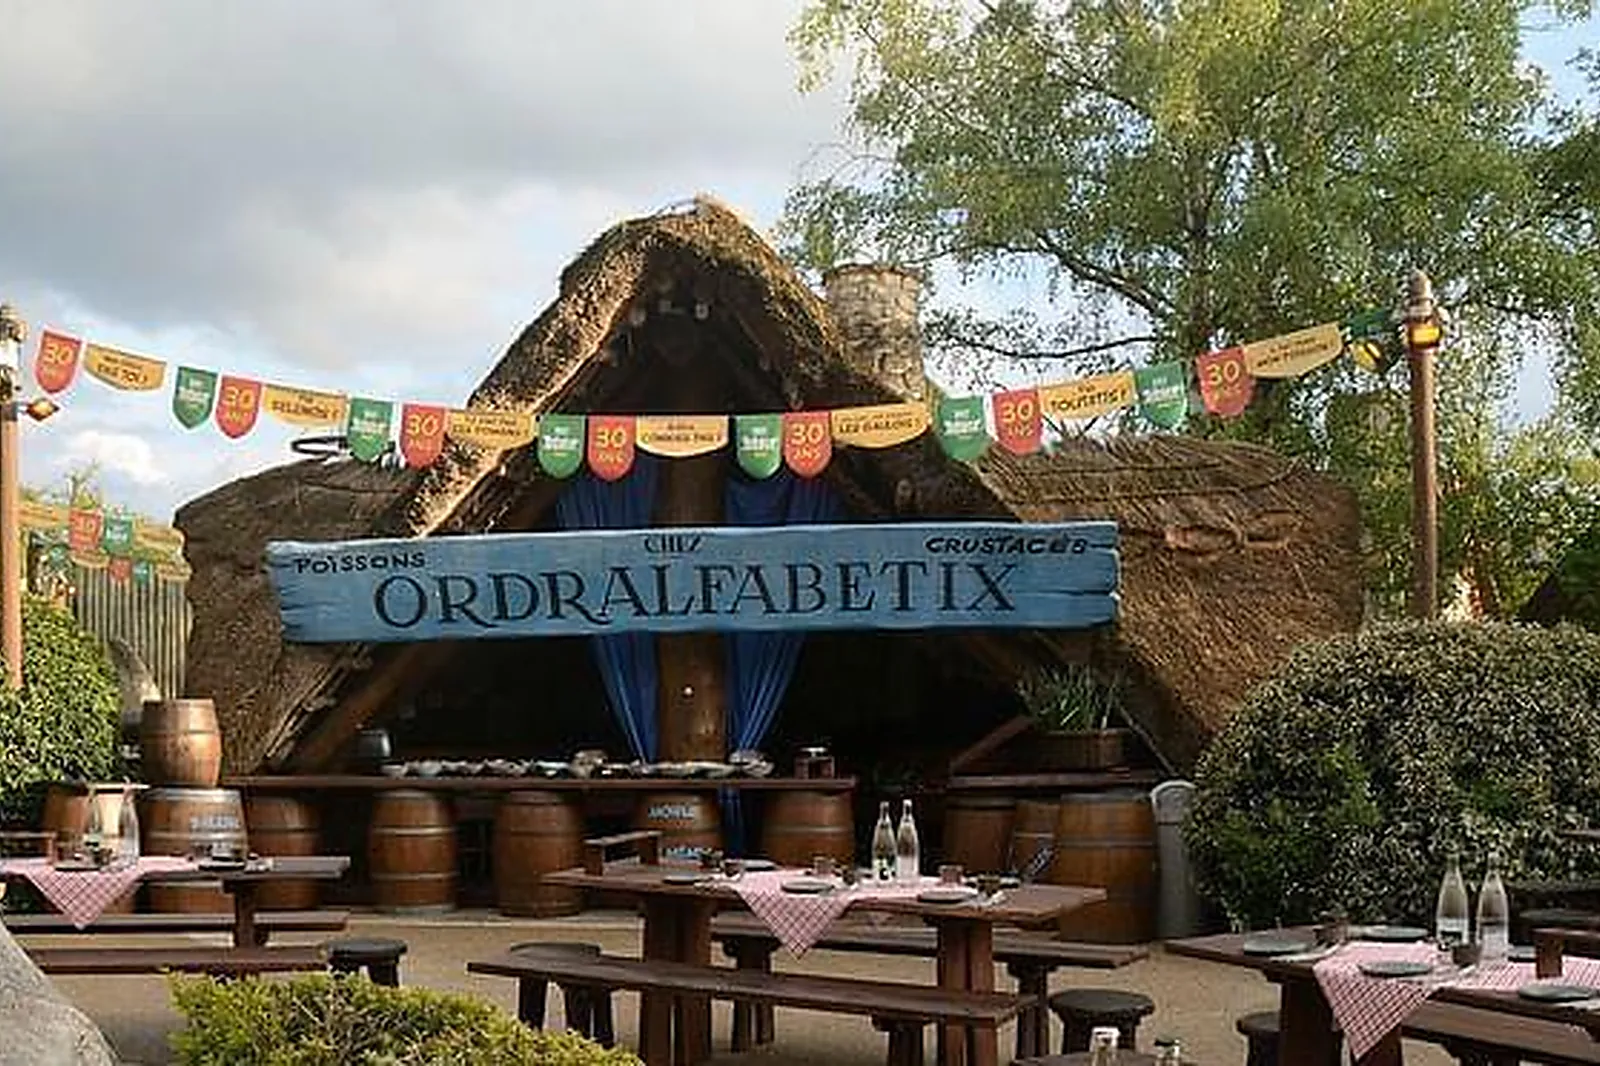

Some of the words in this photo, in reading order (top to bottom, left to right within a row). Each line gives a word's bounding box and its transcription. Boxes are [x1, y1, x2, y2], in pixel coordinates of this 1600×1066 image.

[45, 342, 74, 364] 30
[1205, 360, 1240, 386] 30
[225, 384, 255, 409] 30
[1002, 399, 1034, 423] 30
[407, 413, 439, 436] 30
[791, 422, 824, 445] 30
[596, 427, 627, 448] 30
[644, 533, 701, 553] CHEZ
[373, 561, 1018, 628] ORDRALFABETIX
